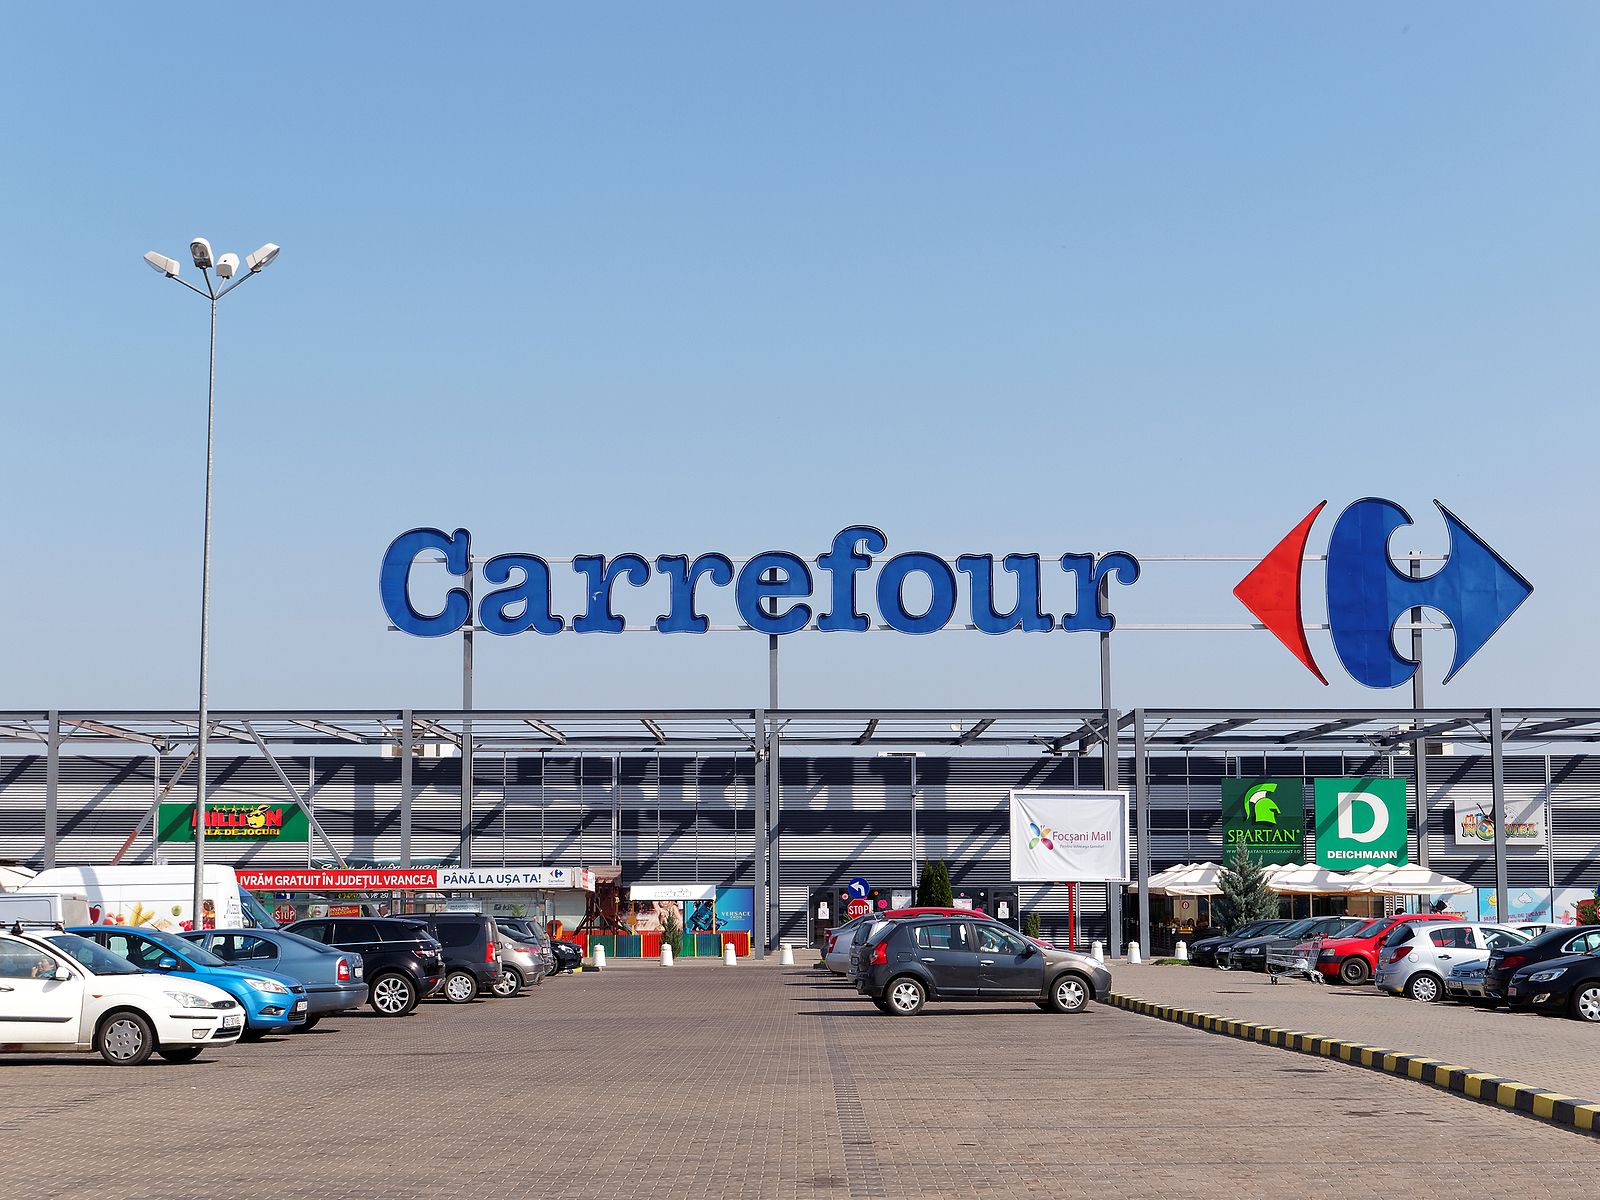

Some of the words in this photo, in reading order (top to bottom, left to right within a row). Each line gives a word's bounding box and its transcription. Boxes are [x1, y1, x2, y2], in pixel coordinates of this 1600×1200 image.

[379, 525, 1140, 638] Carrefour
[225, 828, 239, 836] DE
[241, 828, 280, 836] JOCURI
[1052, 831, 1089, 843] Focșani
[1091, 831, 1112, 841] Mall
[1227, 829, 1296, 842] SPARTAN
[1327, 850, 1398, 859] DEICHMANN
[238, 872, 273, 886] IVRĂM
[274, 875, 320, 886] GRATUIT
[322, 872, 333, 886] ÎN
[384, 874, 434, 885] VRANCEA
[443, 872, 476, 884] PÂNĂ
[478, 874, 494, 884] LA
[496, 874, 520, 886] UȘA
[522, 874, 542, 884] TA!
[849, 905, 869, 914] STOP
